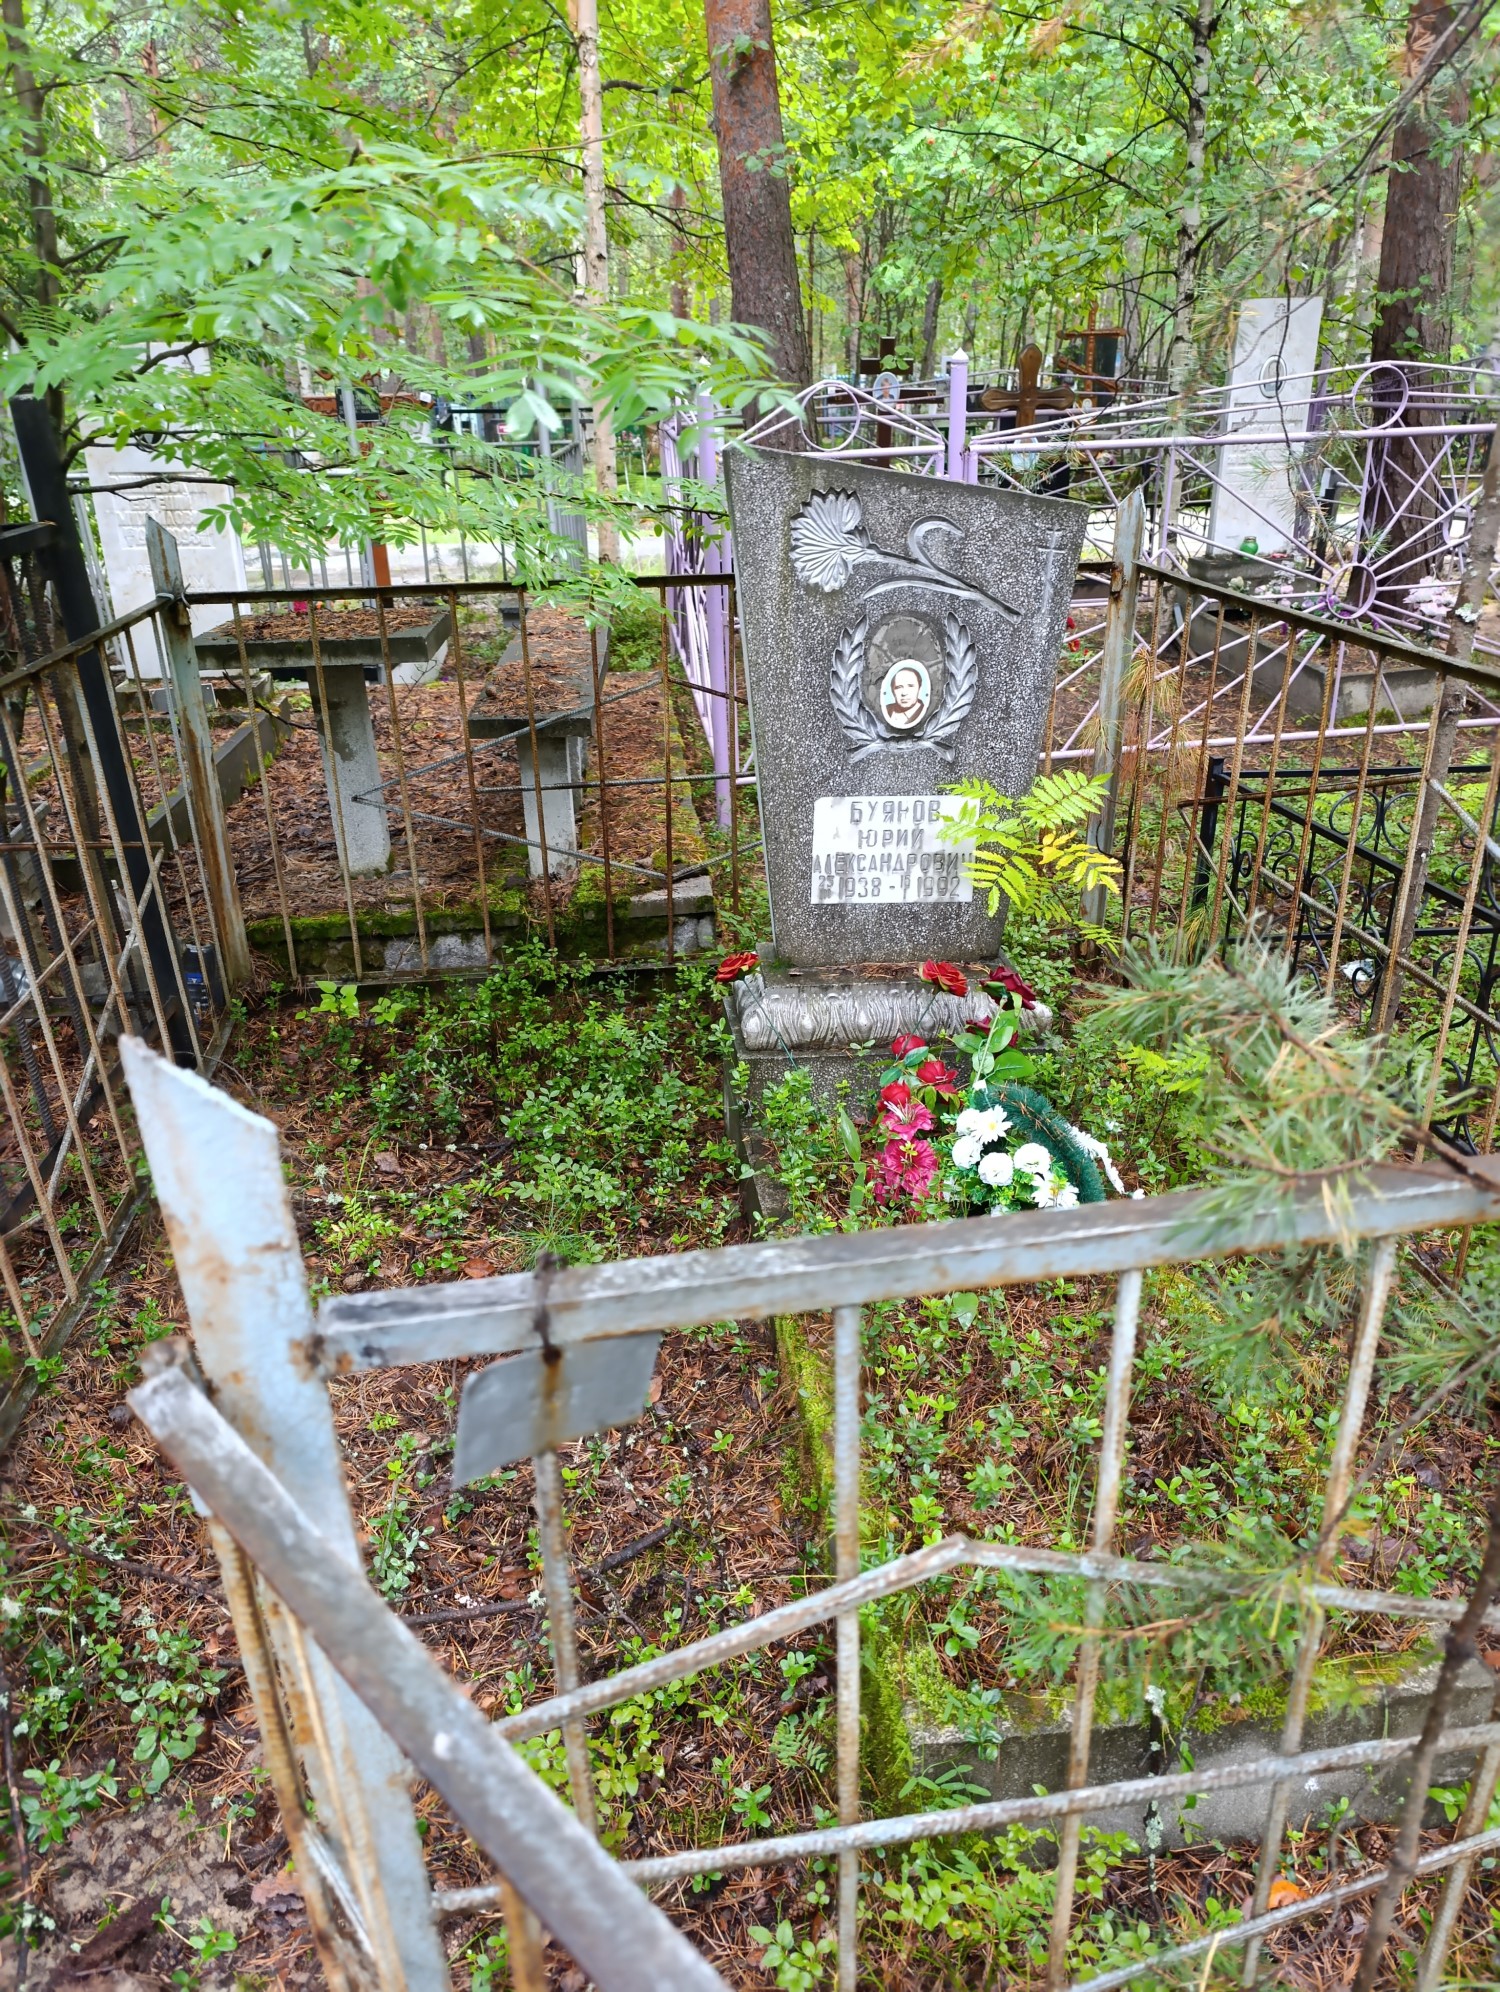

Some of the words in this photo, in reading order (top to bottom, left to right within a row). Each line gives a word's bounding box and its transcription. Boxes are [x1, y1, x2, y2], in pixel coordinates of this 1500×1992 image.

[850, 799, 941, 824] БУЯНОВ
[838, 876, 882, 899] 1938
[917, 875, 961, 898] 1992
